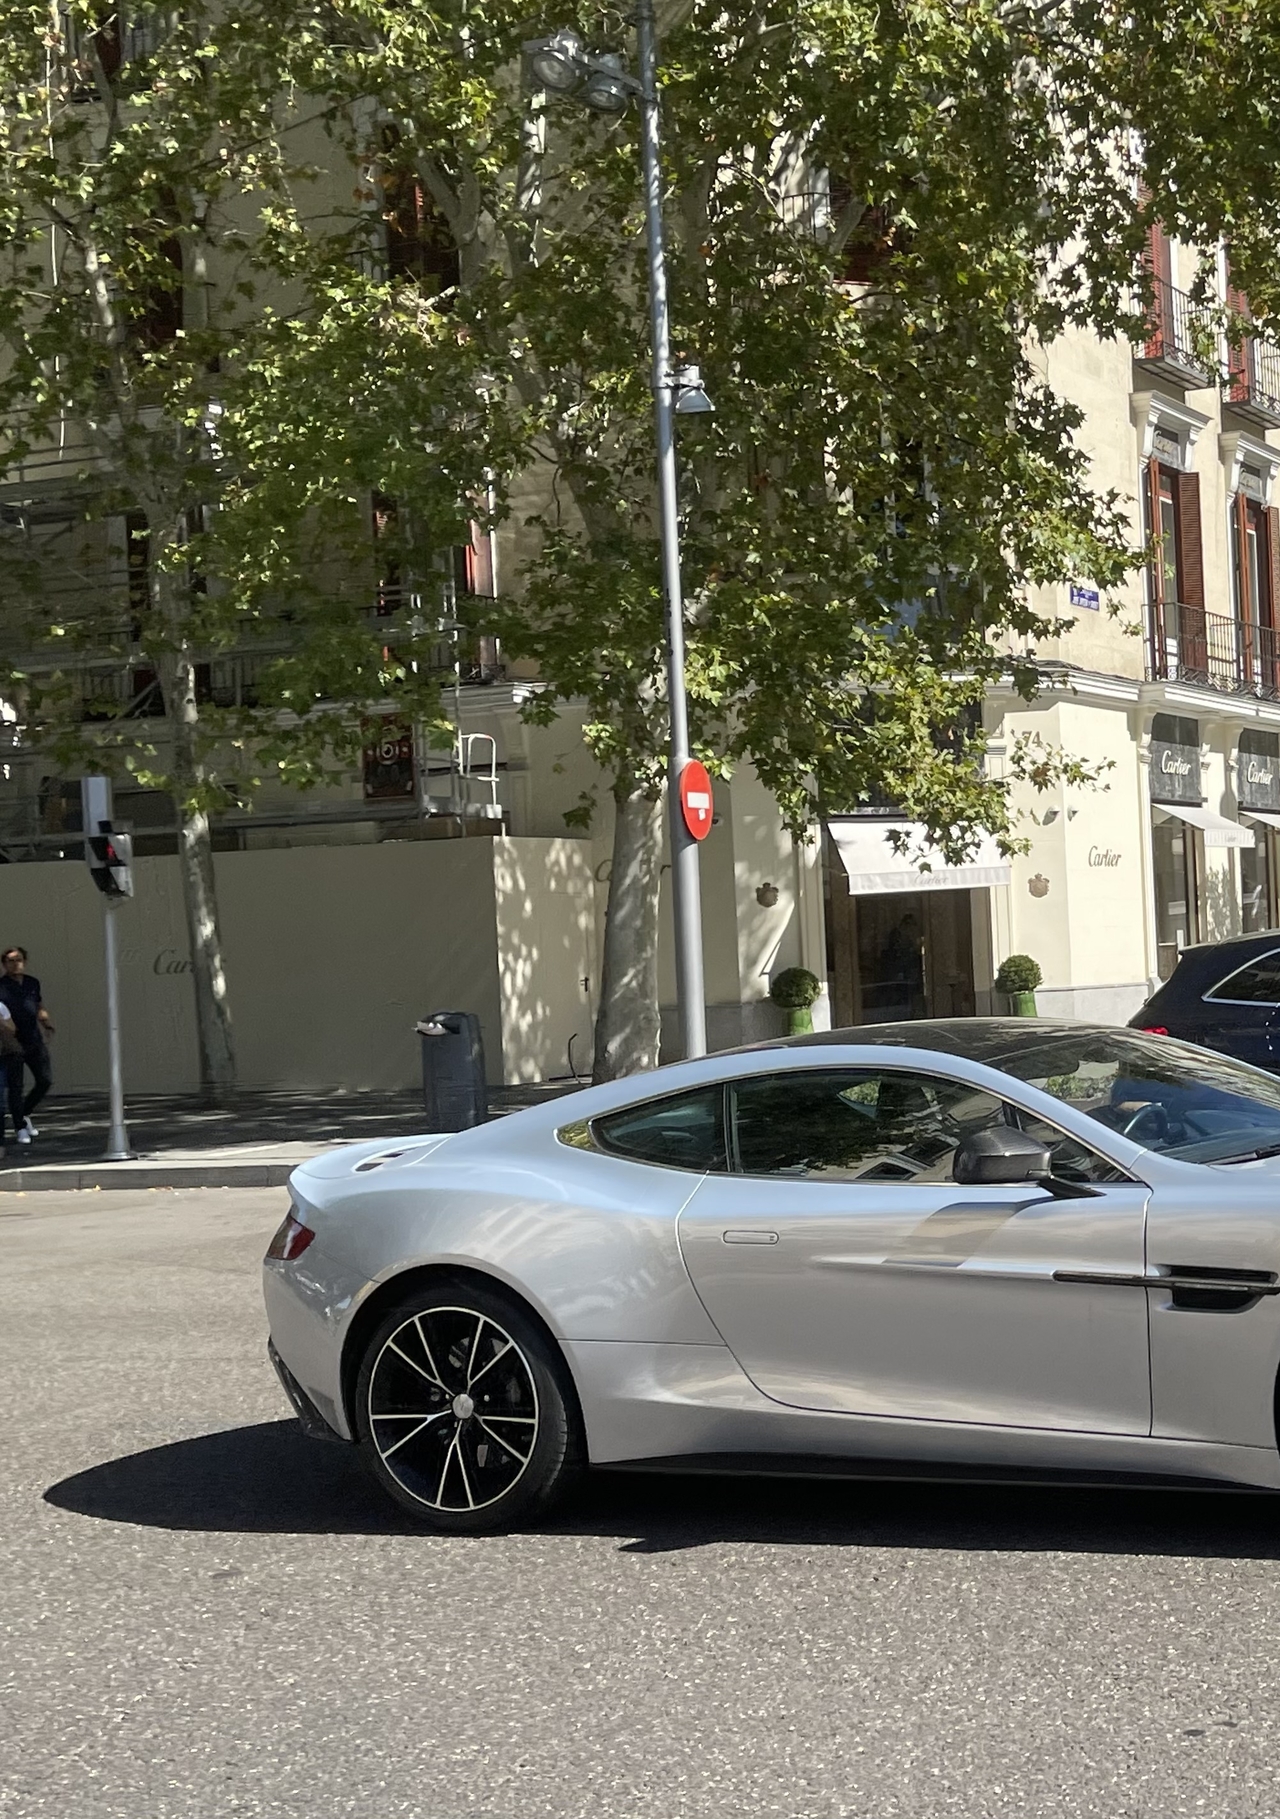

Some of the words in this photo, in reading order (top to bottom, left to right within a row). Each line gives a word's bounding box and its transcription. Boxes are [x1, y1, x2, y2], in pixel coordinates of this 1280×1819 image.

[1022, 731, 1041, 747] 74
[1162, 750, 1192, 776] Cartier
[1247, 761, 1274, 786] Cartier
[1088, 846, 1122, 867] Cartier
